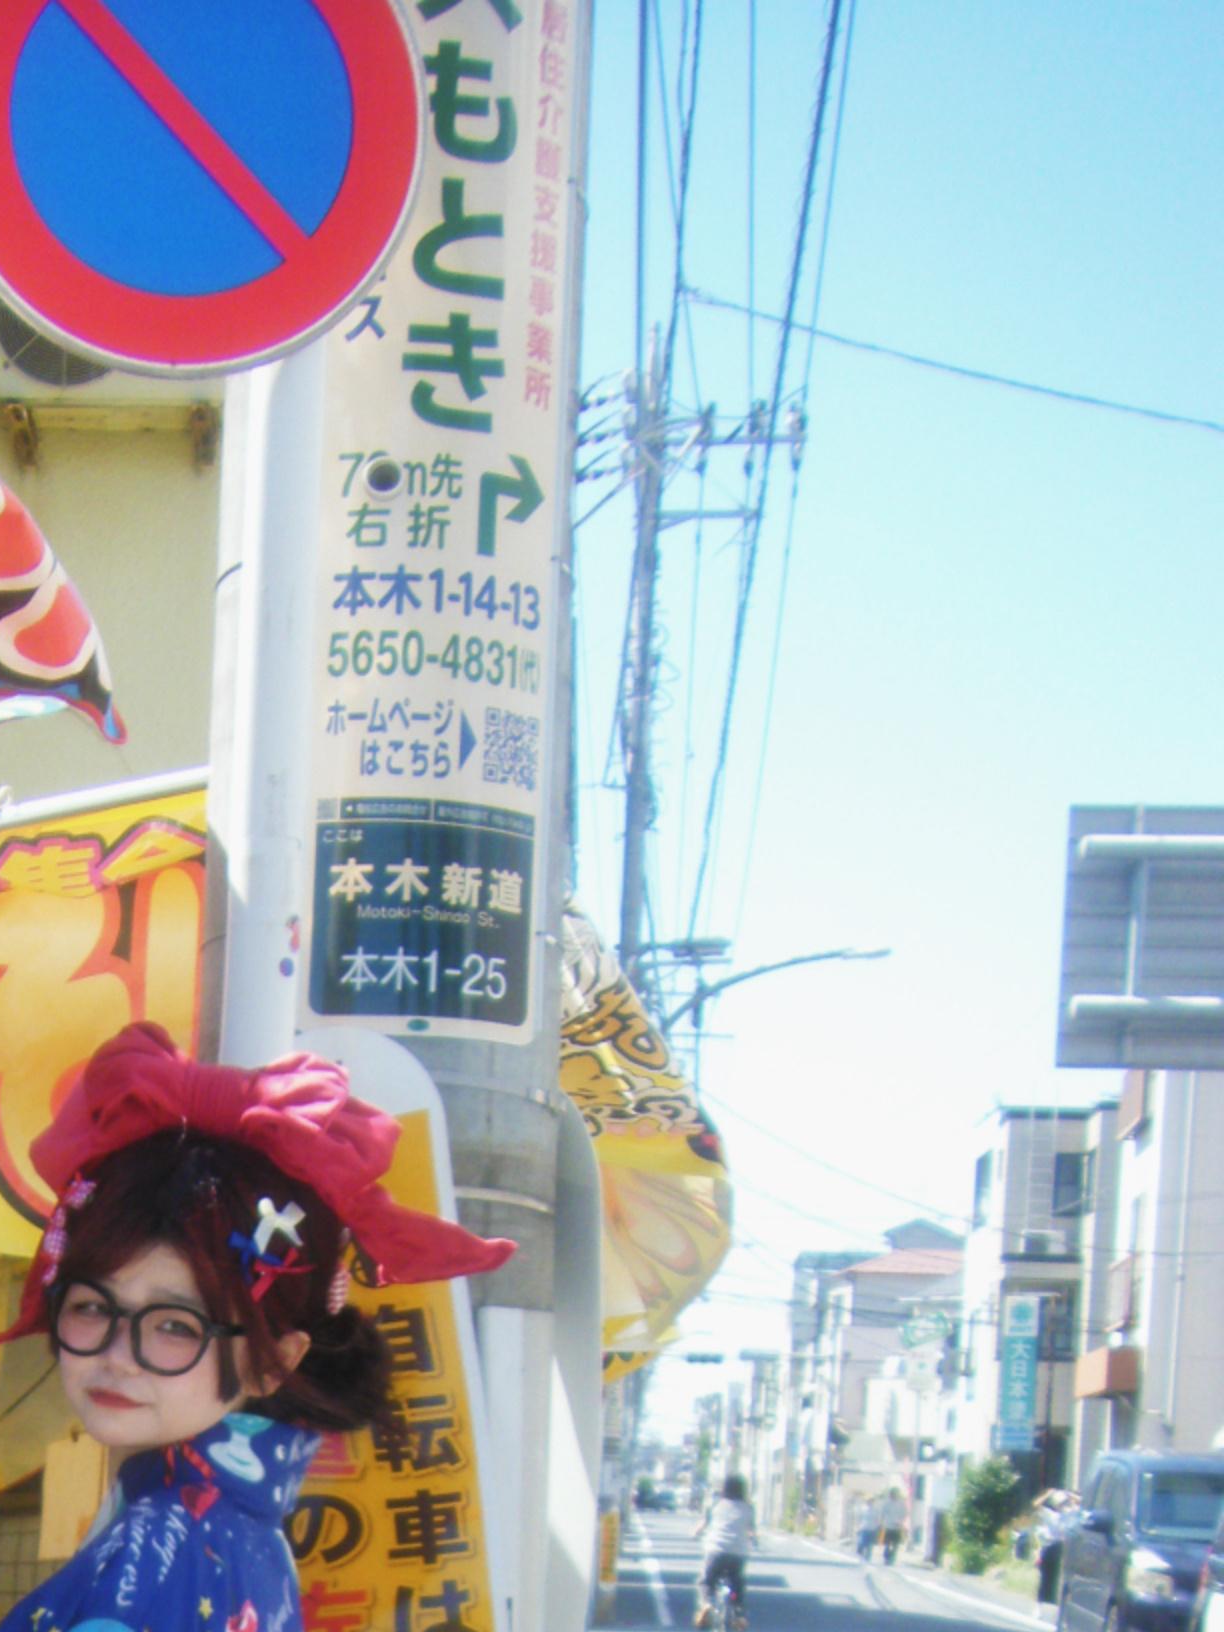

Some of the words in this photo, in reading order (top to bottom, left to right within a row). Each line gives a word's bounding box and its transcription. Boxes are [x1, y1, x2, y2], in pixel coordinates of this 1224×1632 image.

[402, 0, 522, 433] もとき
[345, 274, 386, 342] ス
[338, 450, 464, 500] 7m先
[332, 563, 541, 631] 本木1-14-13
[326, 697, 455, 736] ホームページ
[359, 738, 452, 779] はこちら
[328, 856, 524, 915] 本木新道
[340, 945, 507, 999] 本木1-25
